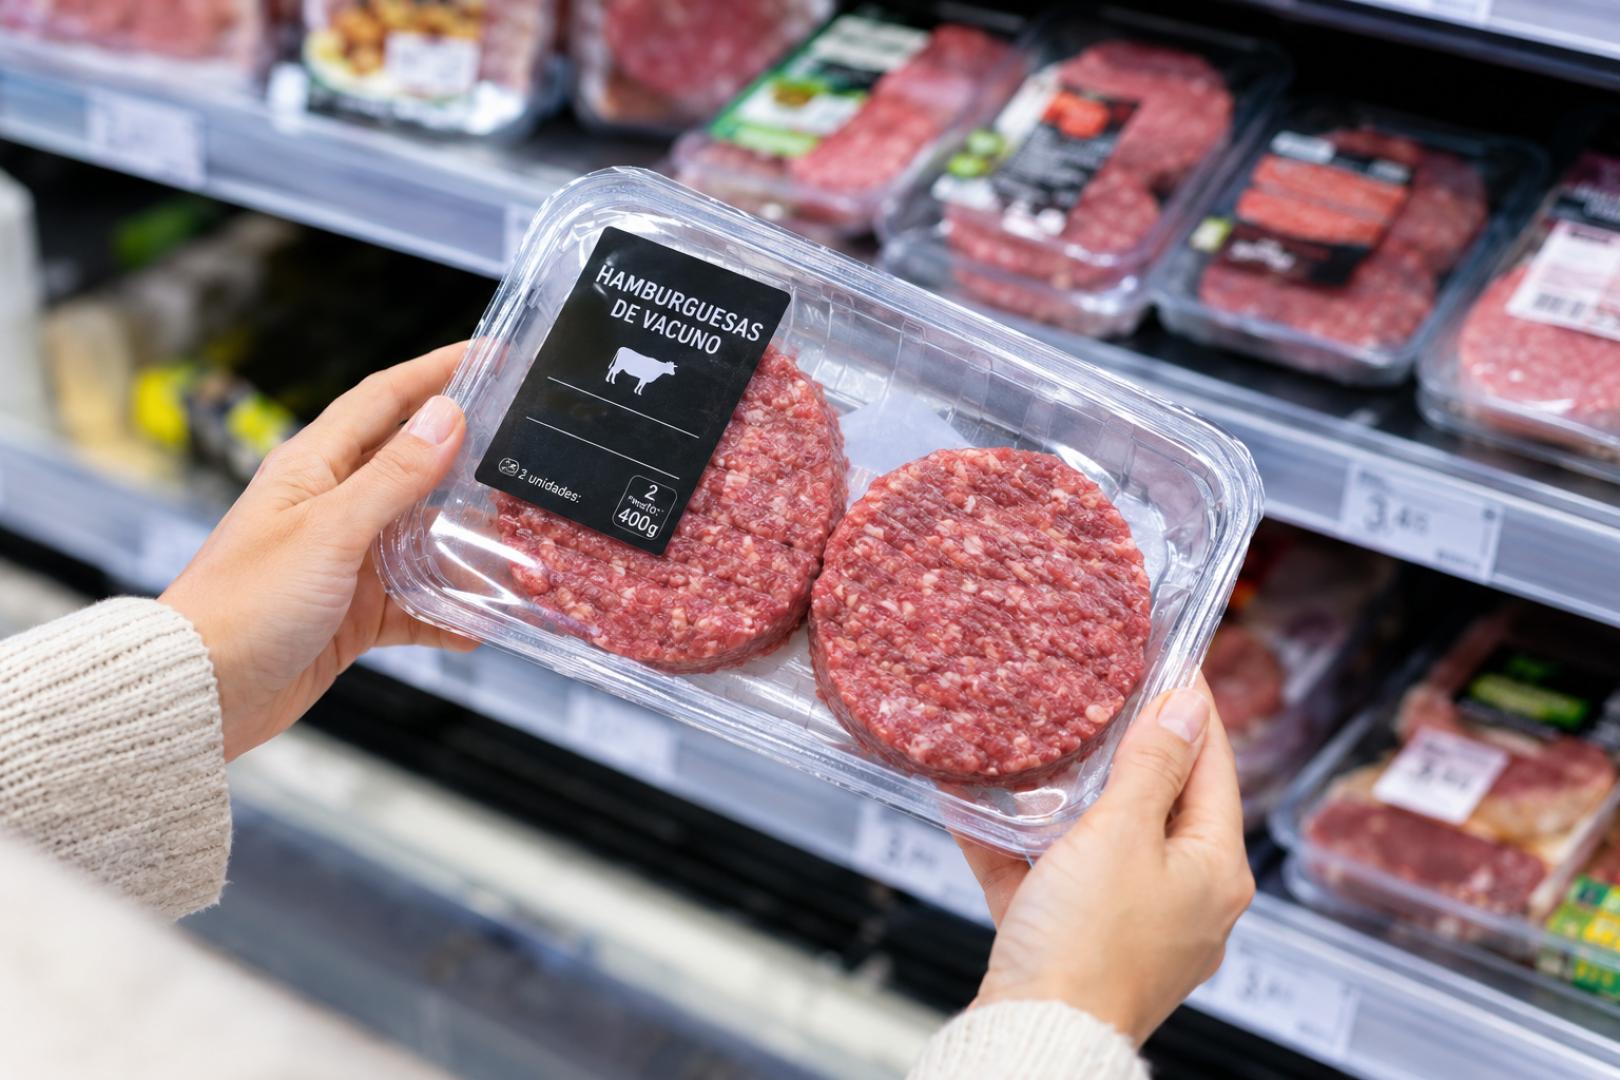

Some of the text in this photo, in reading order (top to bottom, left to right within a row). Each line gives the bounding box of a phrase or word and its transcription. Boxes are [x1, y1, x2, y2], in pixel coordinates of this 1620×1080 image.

[595, 264, 764, 342] HAMBURGUESAS
[610, 298, 722, 355] DE VACUNO
[528, 474, 581, 503] unidades:
[643, 484, 659, 502] 2
[617, 507, 659, 538] 400g
